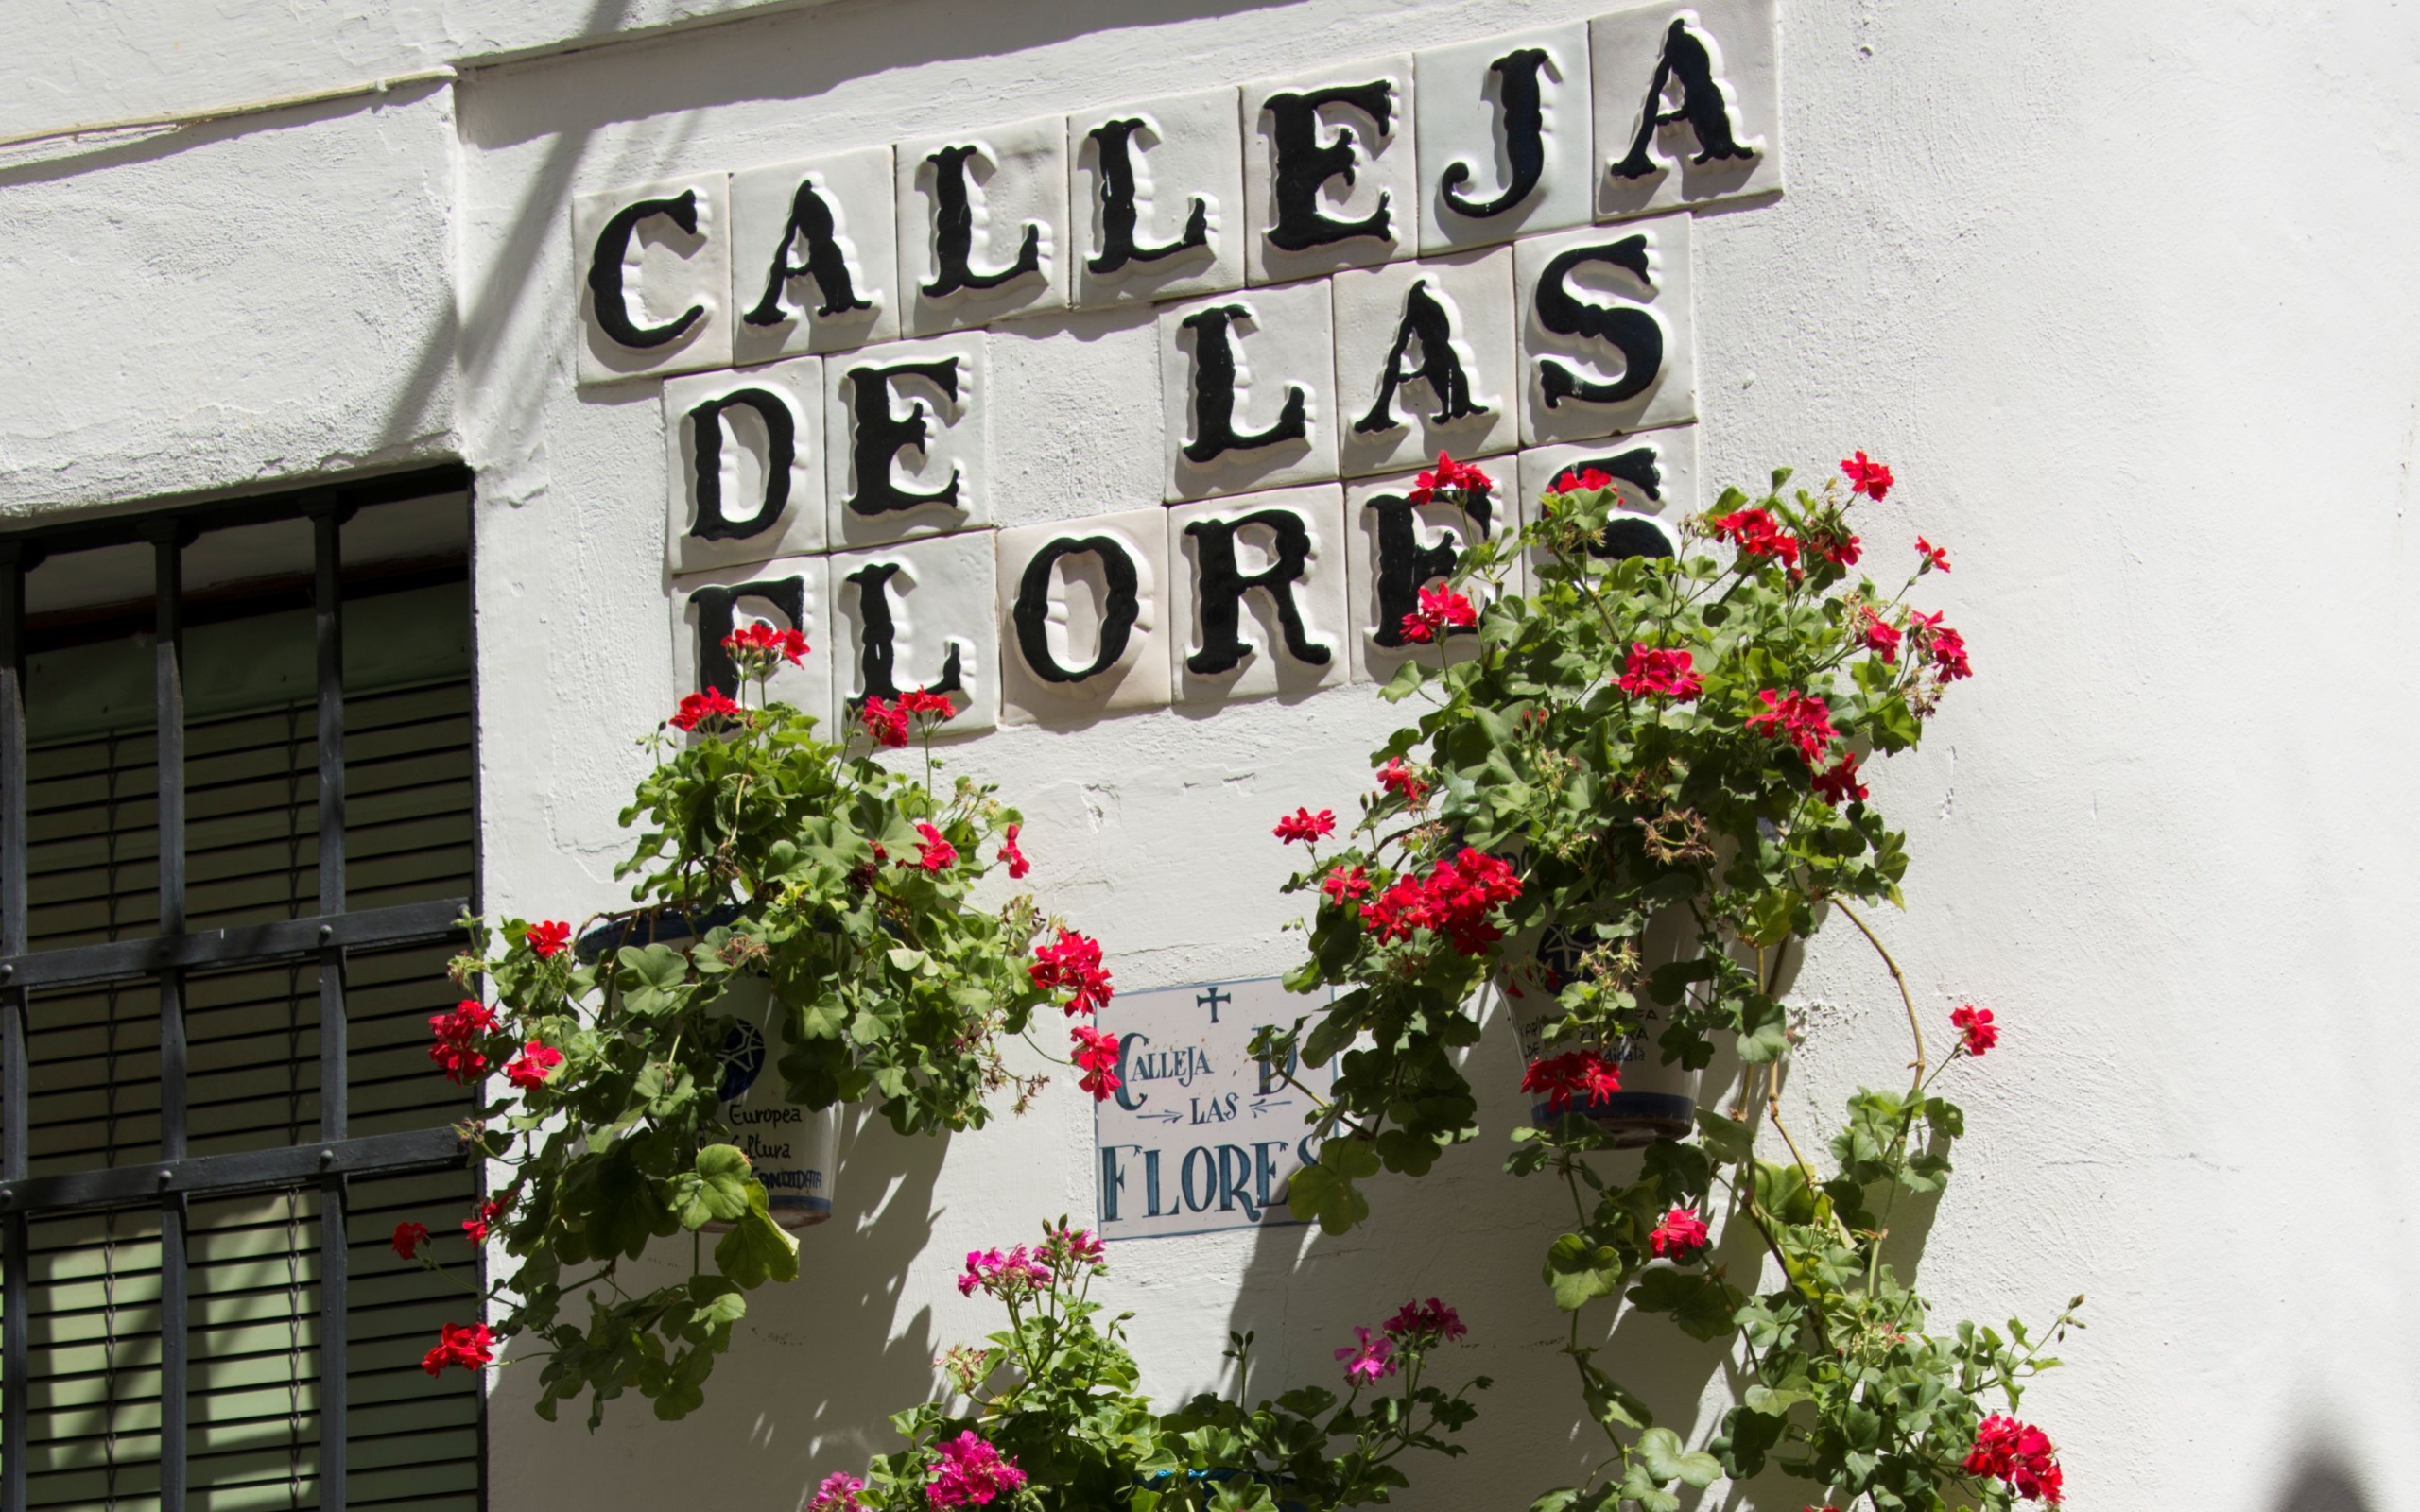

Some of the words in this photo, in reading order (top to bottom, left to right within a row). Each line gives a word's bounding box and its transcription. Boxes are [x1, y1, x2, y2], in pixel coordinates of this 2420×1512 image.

[588, 18, 1758, 349] CALLEJA
[687, 356, 960, 541] DE
[1181, 233, 1665, 463] LAS
[729, 1104, 803, 1130] Europea
[1188, 1091, 1239, 1125] LAS
[730, 1134, 791, 1160] ltura
